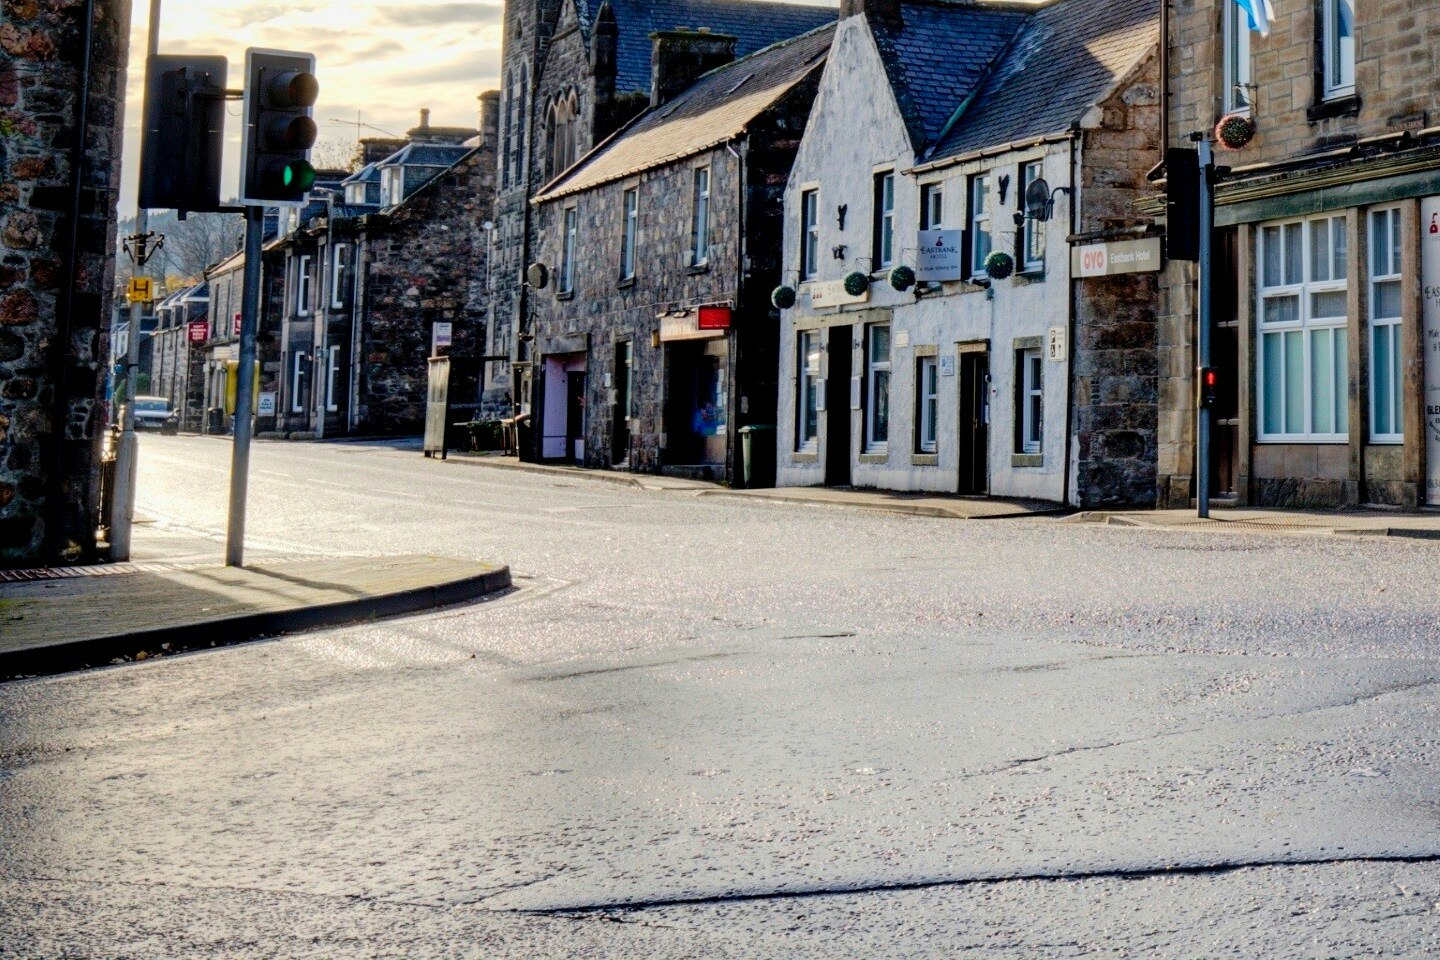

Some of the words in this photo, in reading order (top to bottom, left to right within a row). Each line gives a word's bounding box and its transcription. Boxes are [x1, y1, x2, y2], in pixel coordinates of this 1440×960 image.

[920, 246, 958, 254] EASTBANK
[1083, 250, 1104, 270] OYO
[1110, 251, 1134, 264] Eastbank
[1135, 250, 1150, 261] Hotel
